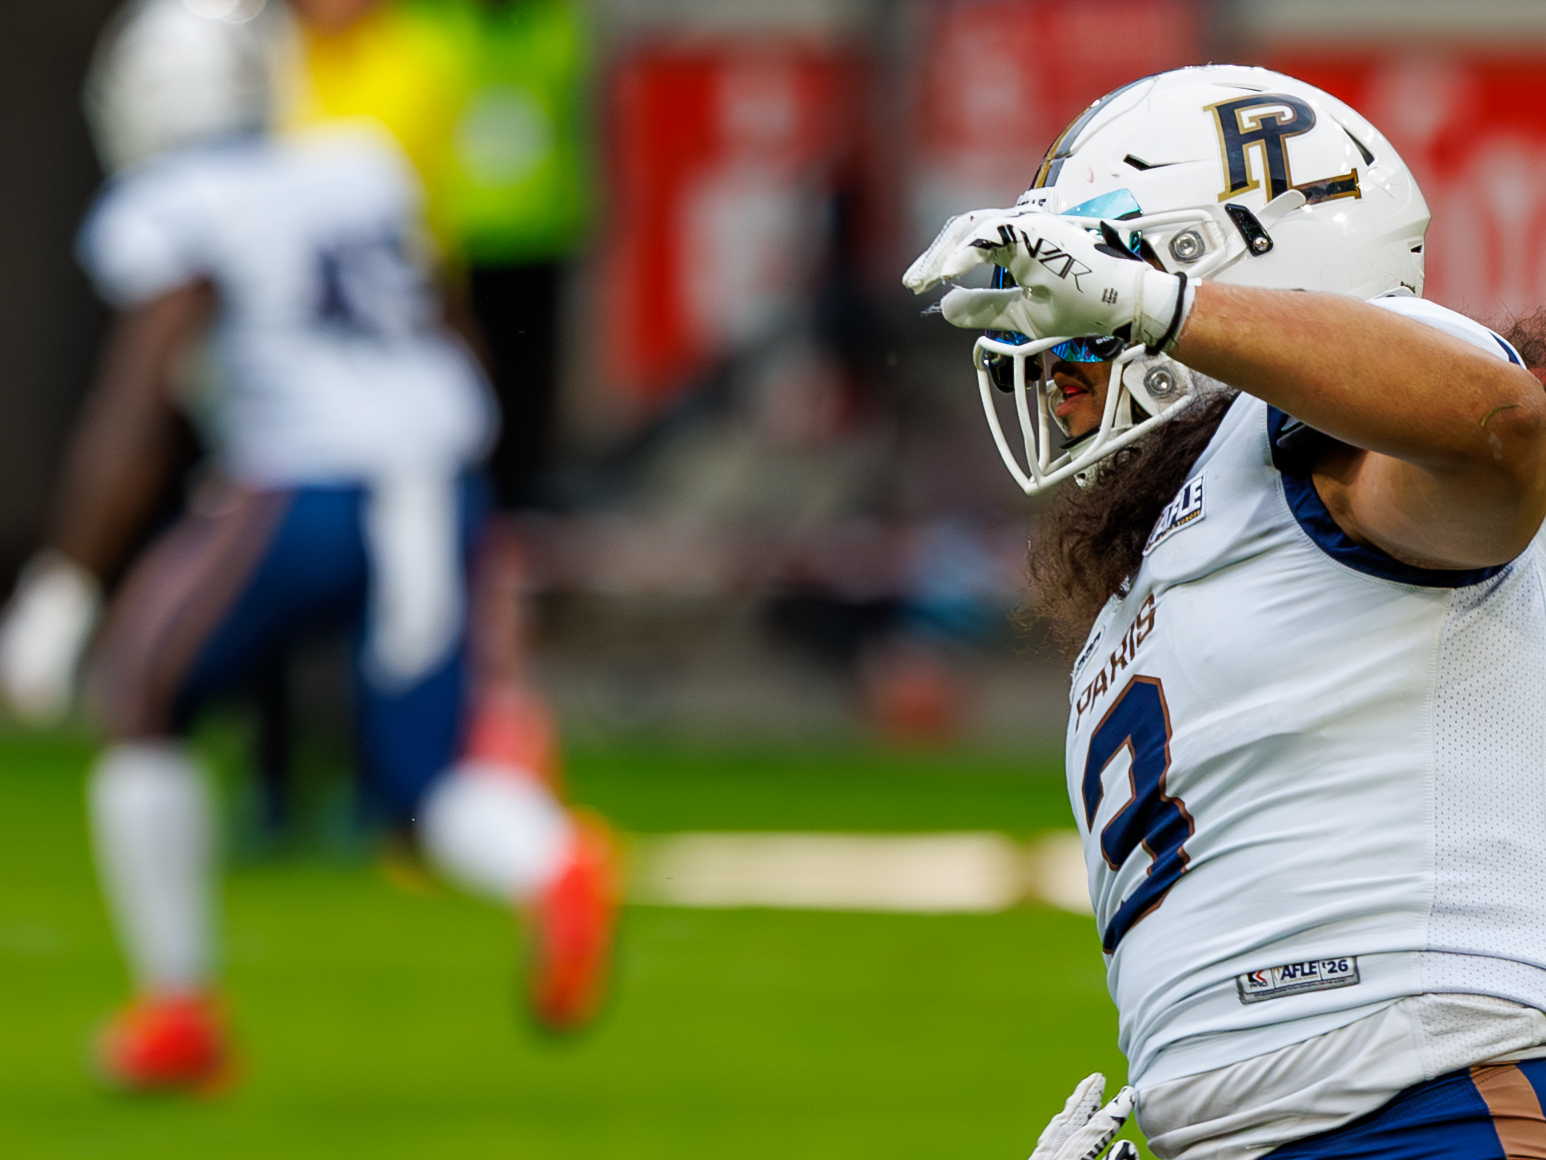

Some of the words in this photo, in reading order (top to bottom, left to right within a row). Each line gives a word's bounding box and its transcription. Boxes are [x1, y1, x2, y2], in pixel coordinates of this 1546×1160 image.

[1082, 674, 1195, 955] 3
[1280, 960, 1318, 981] AFLE
[1321, 958, 1349, 974] '26
